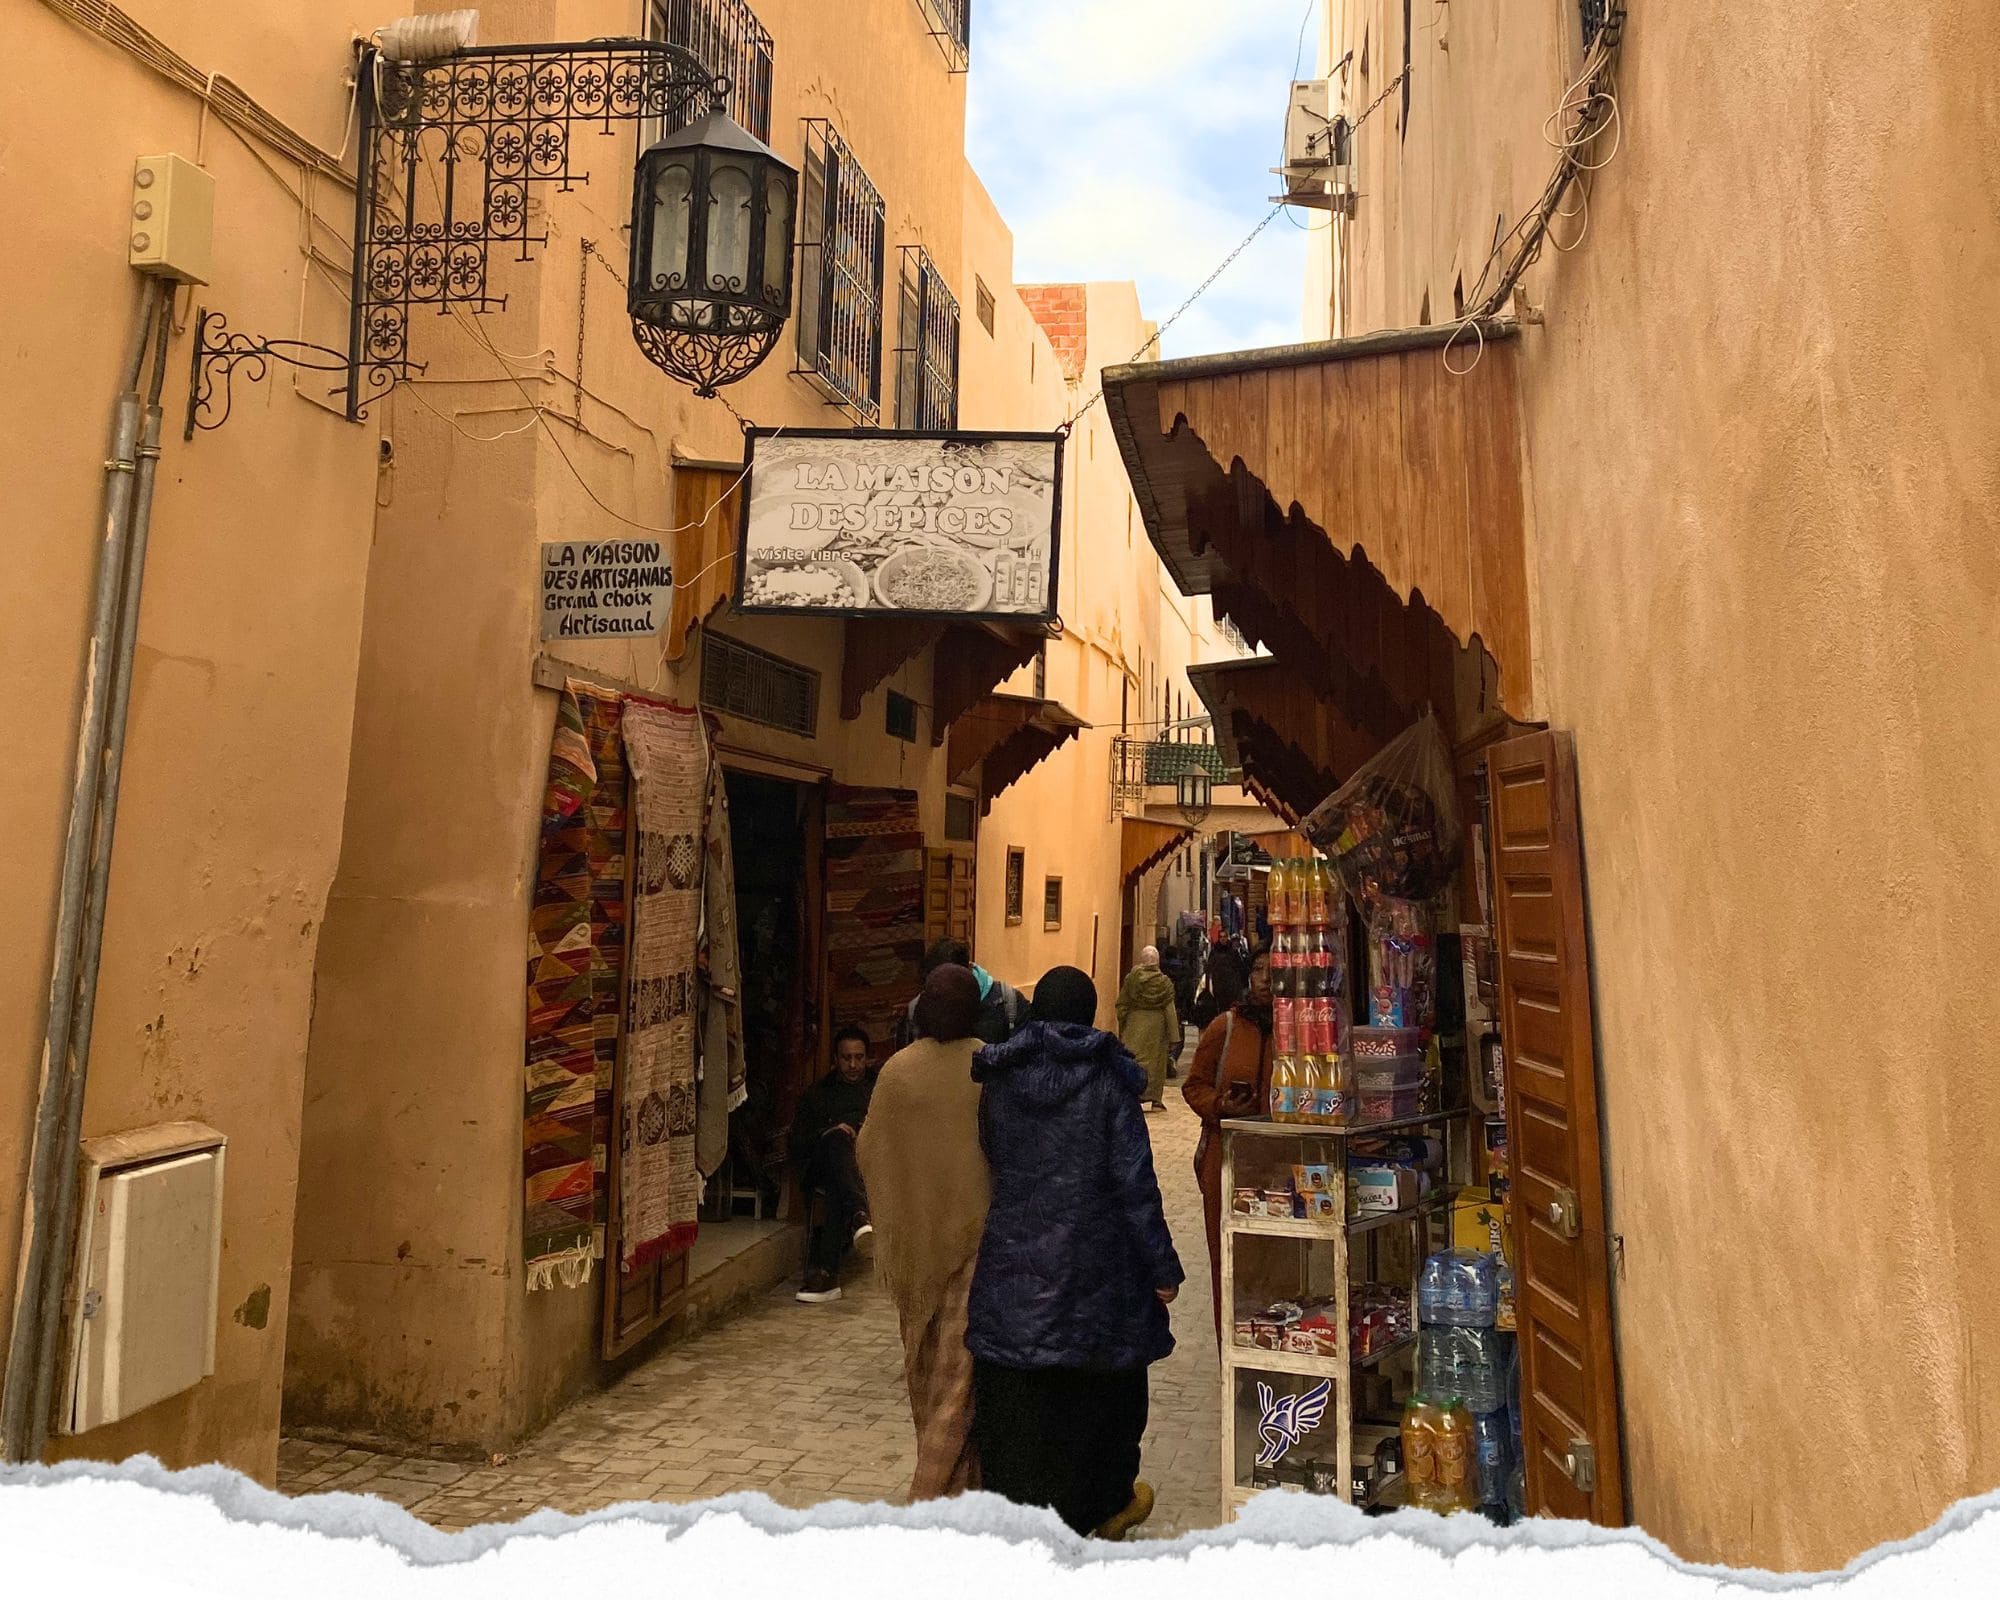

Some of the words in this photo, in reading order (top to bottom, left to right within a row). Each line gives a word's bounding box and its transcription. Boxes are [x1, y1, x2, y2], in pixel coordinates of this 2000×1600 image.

[795, 463, 848, 490] LA
[855, 464, 1013, 494] MAISON
[789, 502, 866, 531] DES
[873, 504, 1014, 536] EPICES
[547, 545, 575, 566] LA
[582, 542, 660, 565] MAISON
[544, 570, 578, 589] DES
[544, 590, 598, 611] Grand
[559, 610, 655, 635] Artisanal
